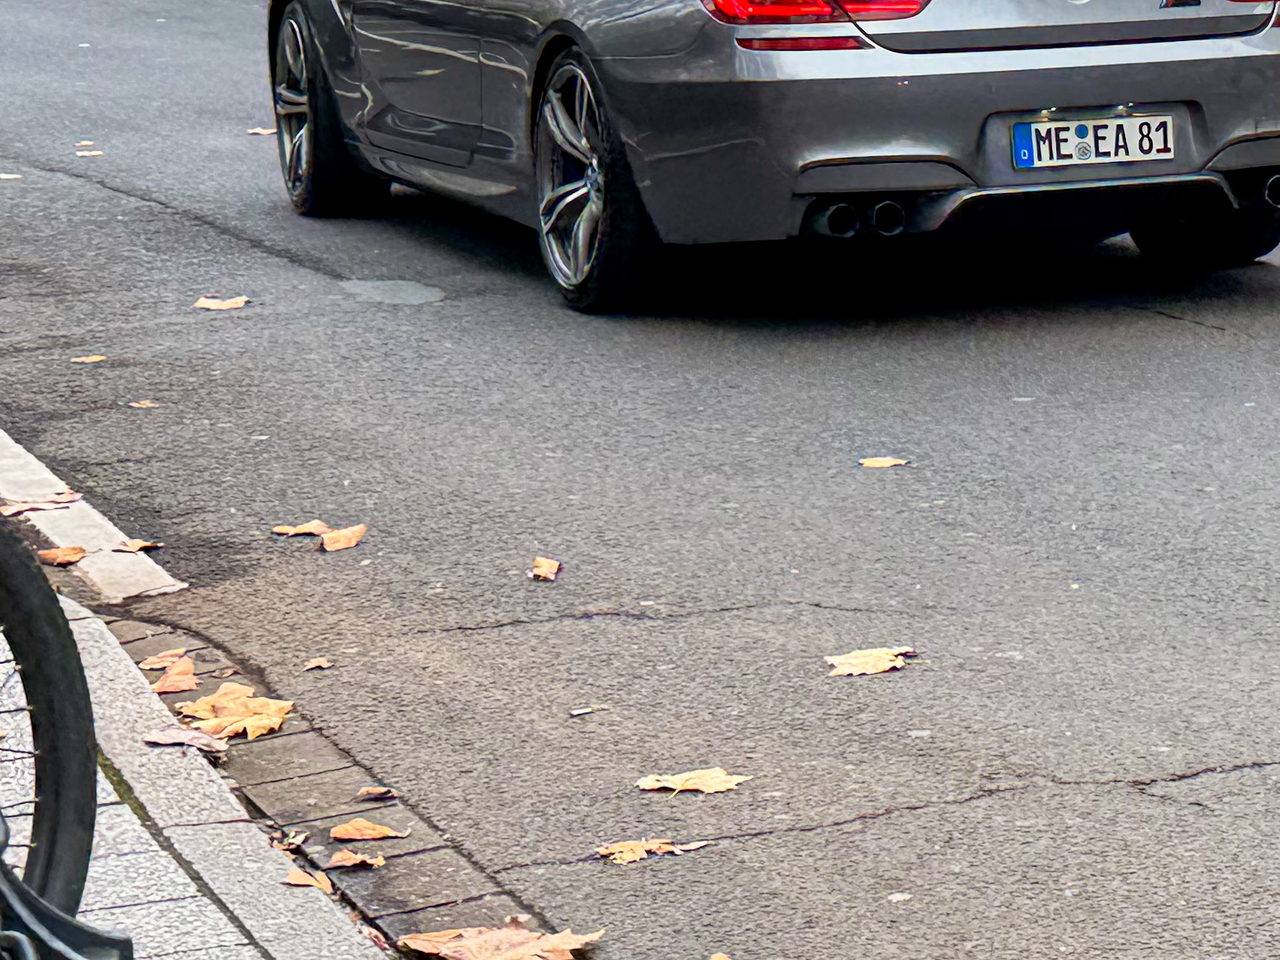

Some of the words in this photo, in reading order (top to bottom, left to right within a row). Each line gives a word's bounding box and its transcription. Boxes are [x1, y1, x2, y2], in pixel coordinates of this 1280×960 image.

[1034, 126, 1074, 162] ME
[1093, 124, 1130, 158] EA
[1138, 120, 1172, 156] 81
